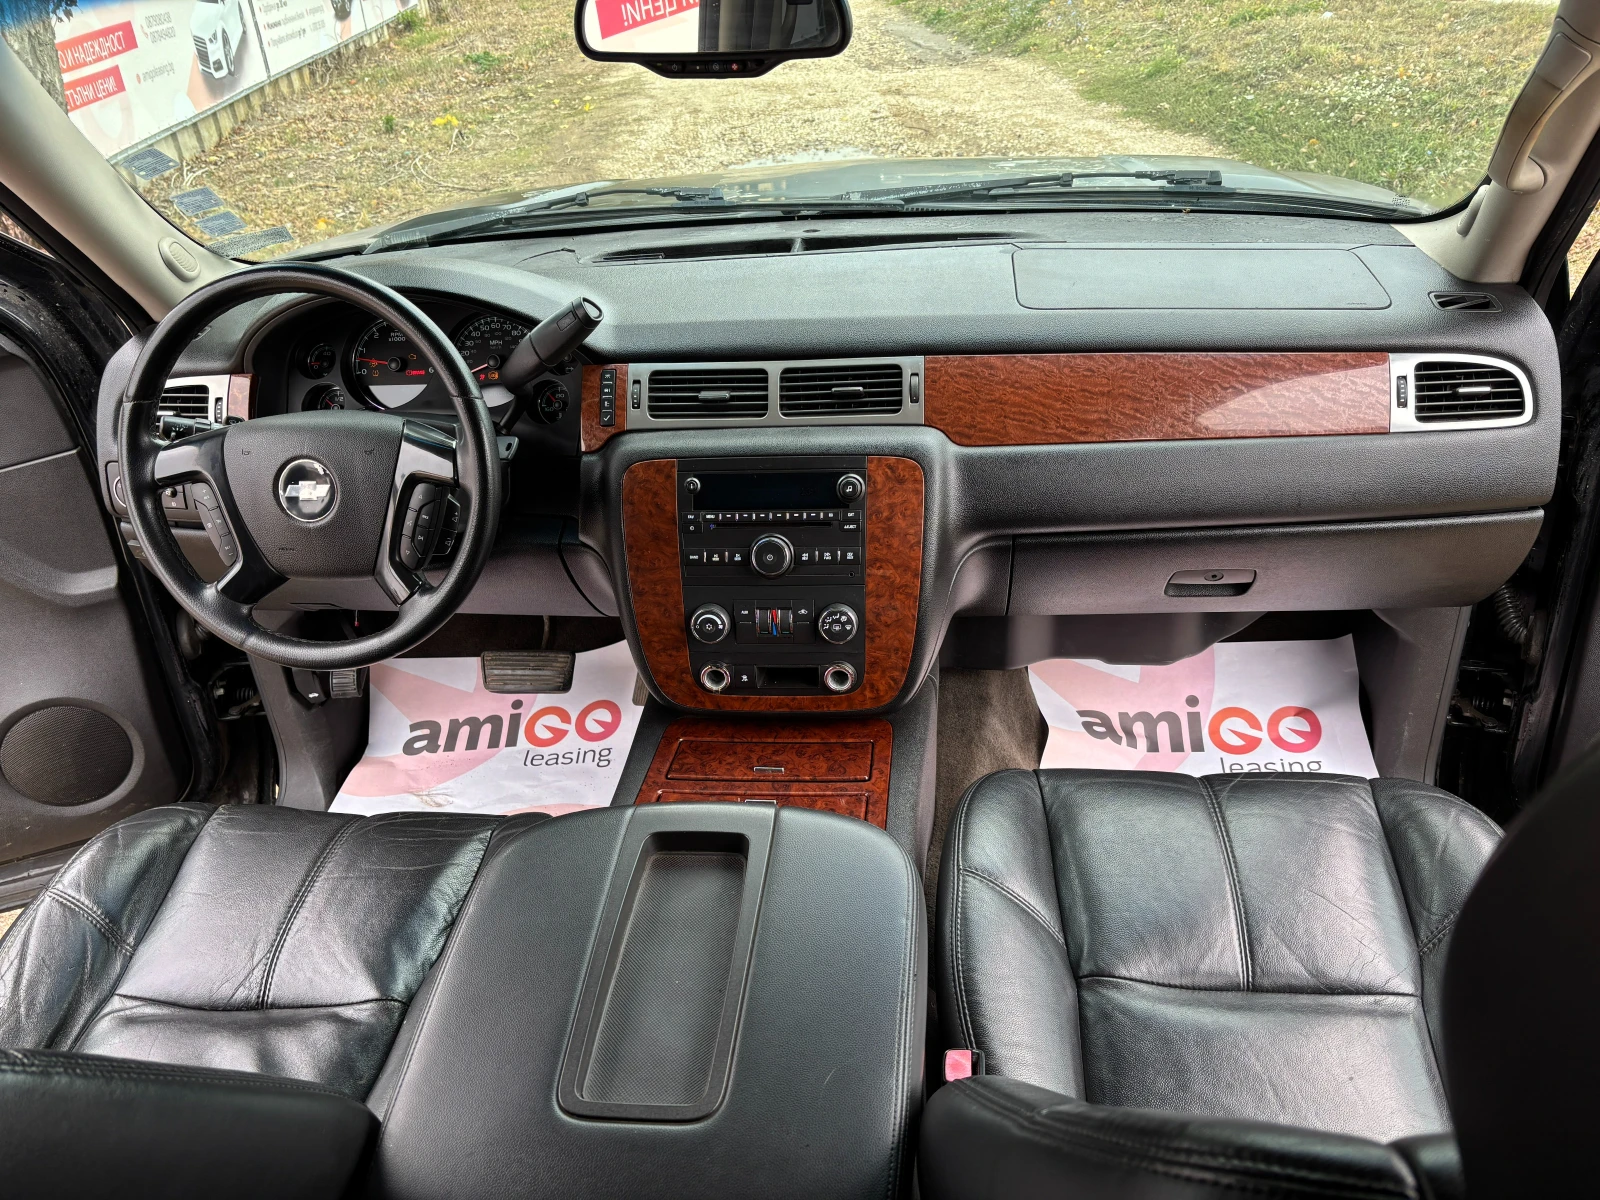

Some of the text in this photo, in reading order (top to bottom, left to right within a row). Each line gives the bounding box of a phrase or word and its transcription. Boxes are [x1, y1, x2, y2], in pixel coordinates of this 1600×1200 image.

[73, 31, 126, 64] НАДЕЖДНОСТ
[93, 76, 118, 100] ЦЕНИ!
[523, 747, 613, 767] leasing
